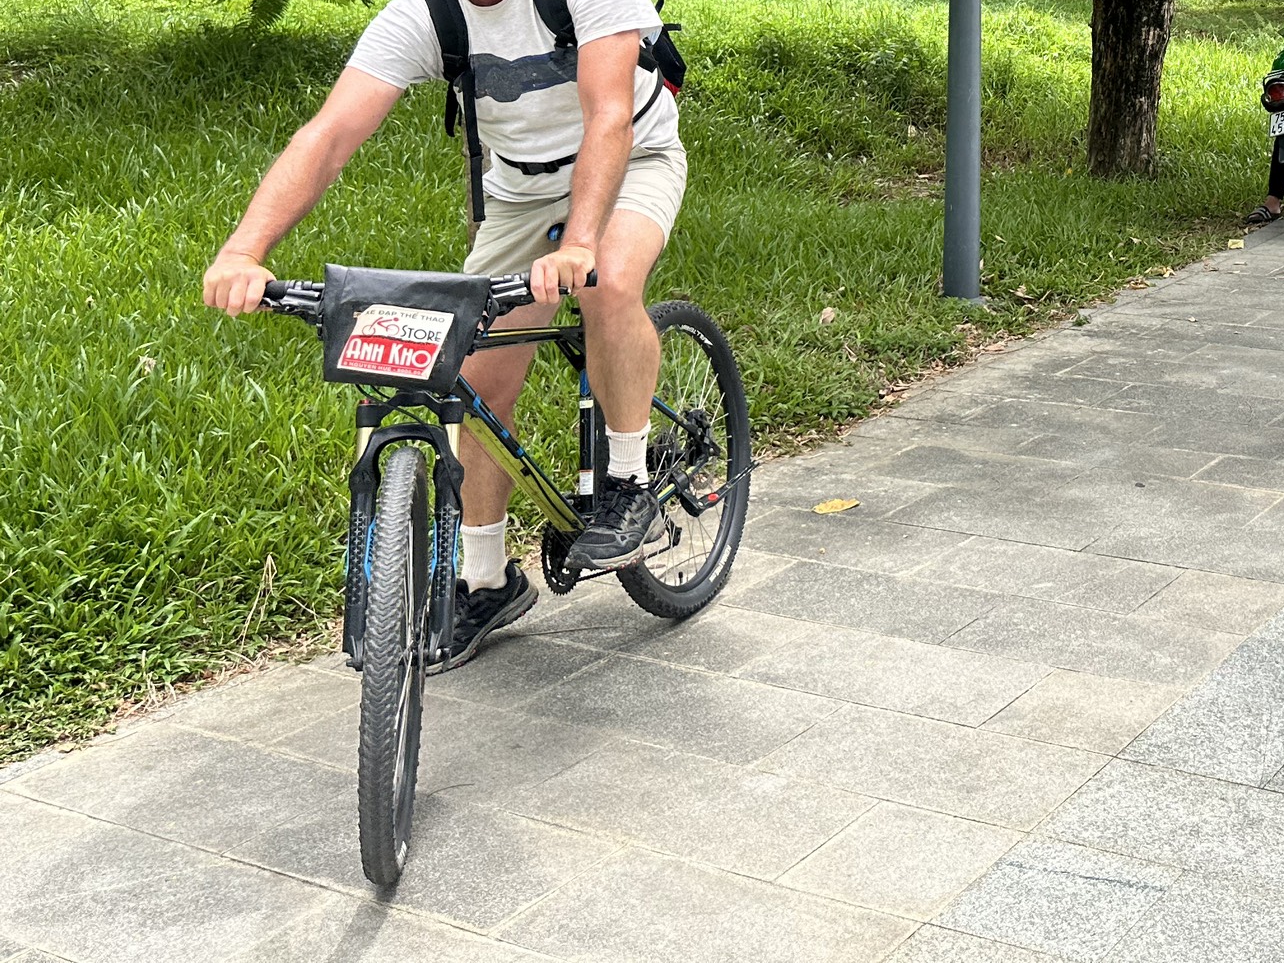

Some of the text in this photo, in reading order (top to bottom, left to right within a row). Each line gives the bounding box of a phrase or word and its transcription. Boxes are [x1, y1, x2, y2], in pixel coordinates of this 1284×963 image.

[421, 314, 446, 323] THAO
[400, 325, 442, 342] STORE
[345, 337, 385, 363] ANH
